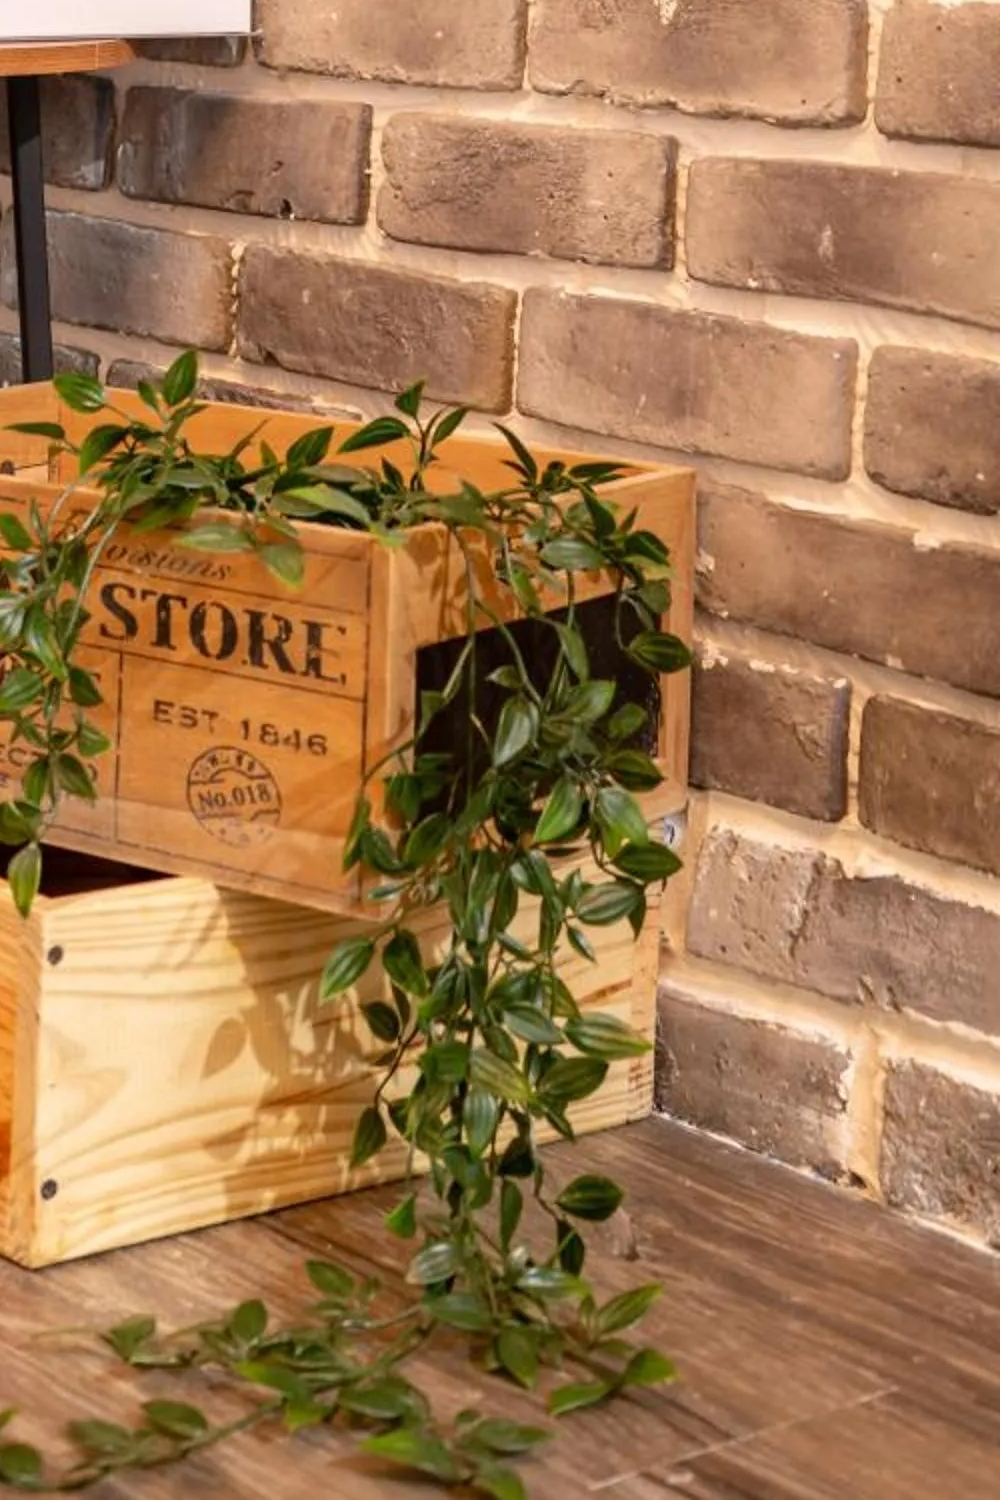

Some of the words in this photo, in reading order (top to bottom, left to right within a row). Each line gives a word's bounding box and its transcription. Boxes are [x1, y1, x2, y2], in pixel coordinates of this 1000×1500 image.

[99, 581, 348, 688] STORE
[151, 699, 219, 735] EST
[240, 717, 329, 756] 1846
[197, 782, 272, 811] No.018
